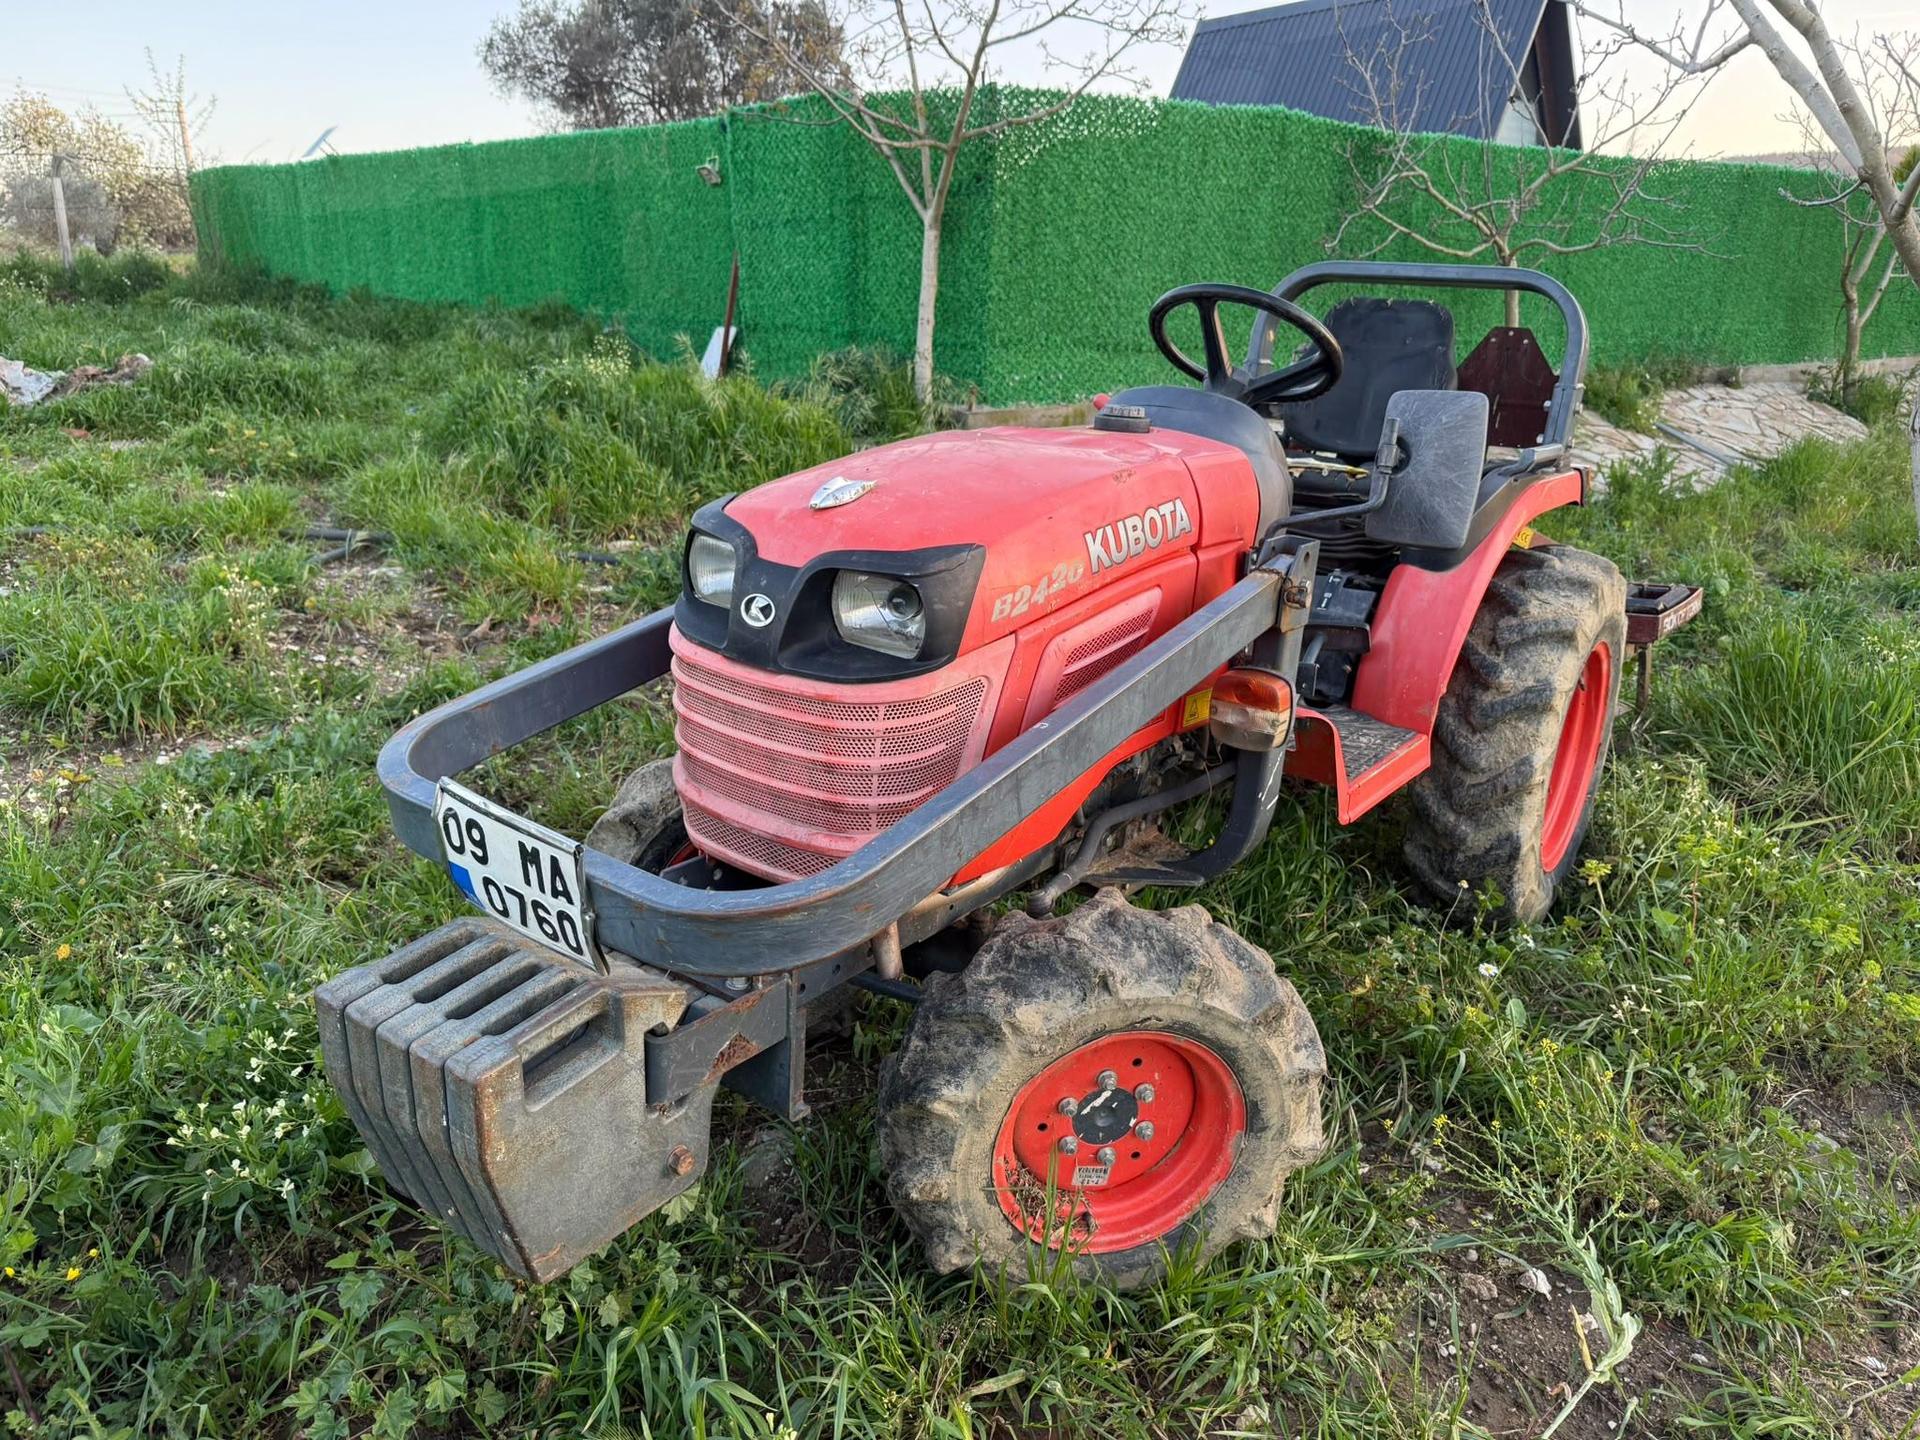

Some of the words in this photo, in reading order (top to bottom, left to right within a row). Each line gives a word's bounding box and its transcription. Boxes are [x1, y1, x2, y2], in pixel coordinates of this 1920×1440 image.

[1084, 497, 1192, 574] KUBOTA
[990, 558, 1085, 622] B2420
[442, 807, 489, 866] 09
[518, 840, 575, 906] MA
[482, 876, 584, 956] 0760
